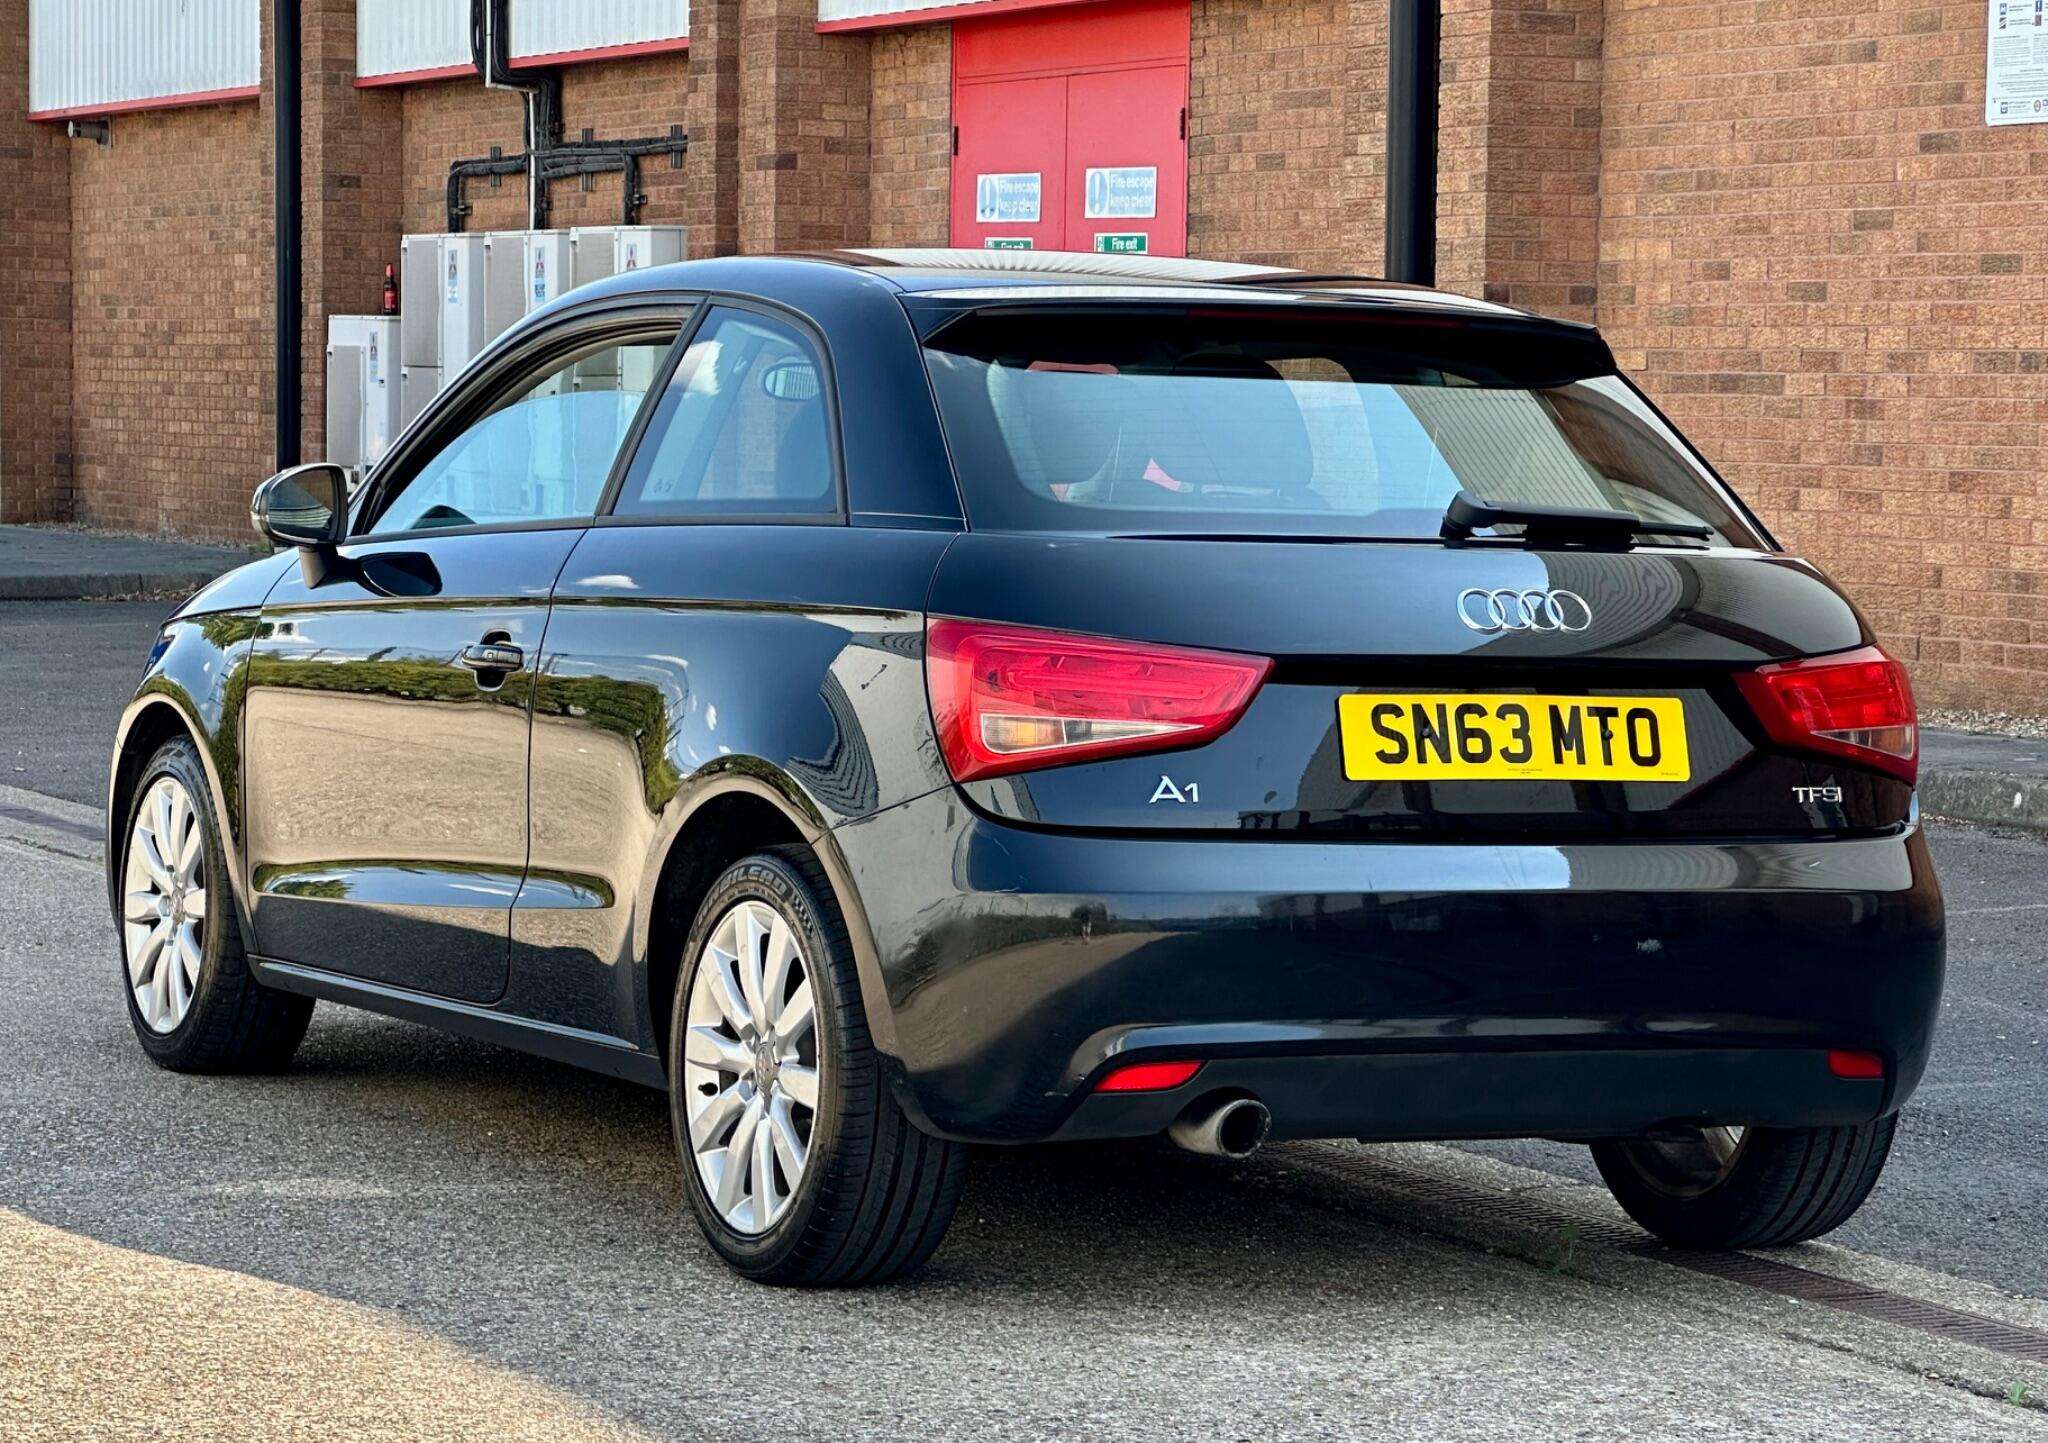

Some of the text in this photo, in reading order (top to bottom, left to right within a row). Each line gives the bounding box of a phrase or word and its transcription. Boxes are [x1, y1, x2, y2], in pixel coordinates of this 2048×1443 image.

[1110, 174, 1125, 188] Fire
[1111, 237, 1138, 250] Fire exit
[1370, 703, 1661, 767] SN63 MTO
[1149, 775, 1199, 803] A1
[1792, 786, 1842, 803] TFSI
